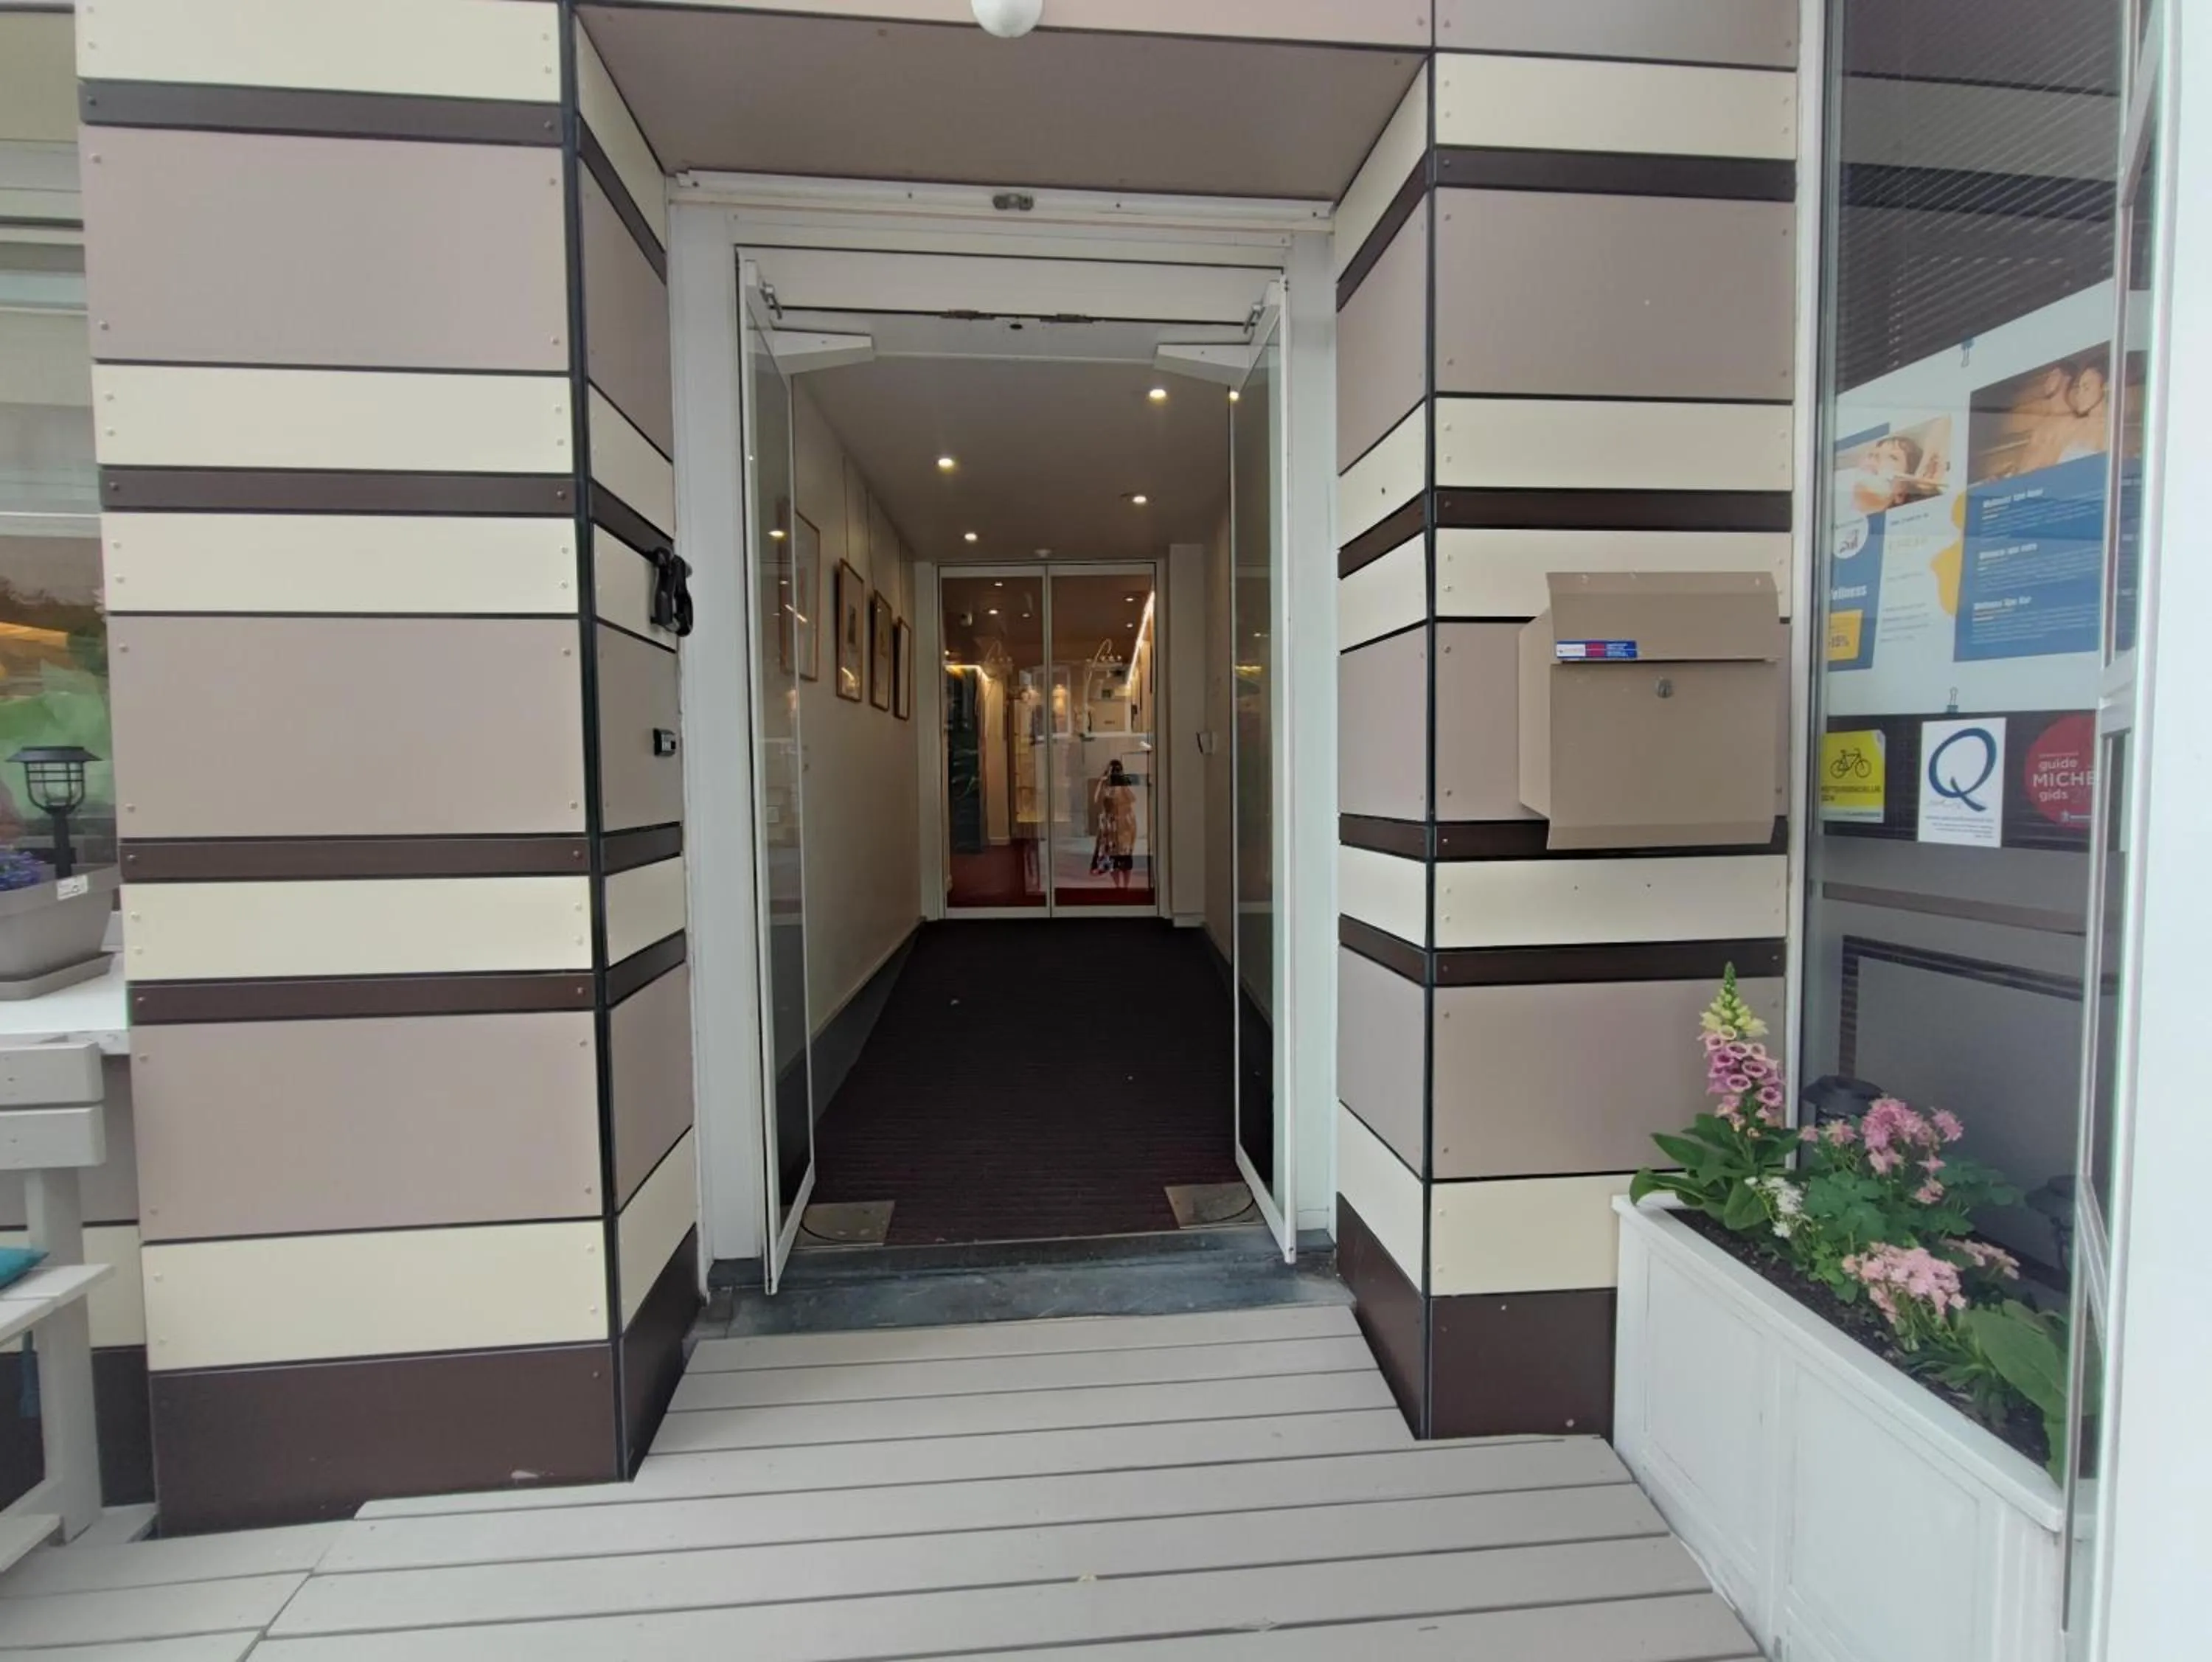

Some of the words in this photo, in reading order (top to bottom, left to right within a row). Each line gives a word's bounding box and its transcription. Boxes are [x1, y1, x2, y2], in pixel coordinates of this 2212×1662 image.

[1928, 727, 1997, 812] Q
[2038, 757, 2079, 771] guide
[2039, 789, 2069, 802] gids
